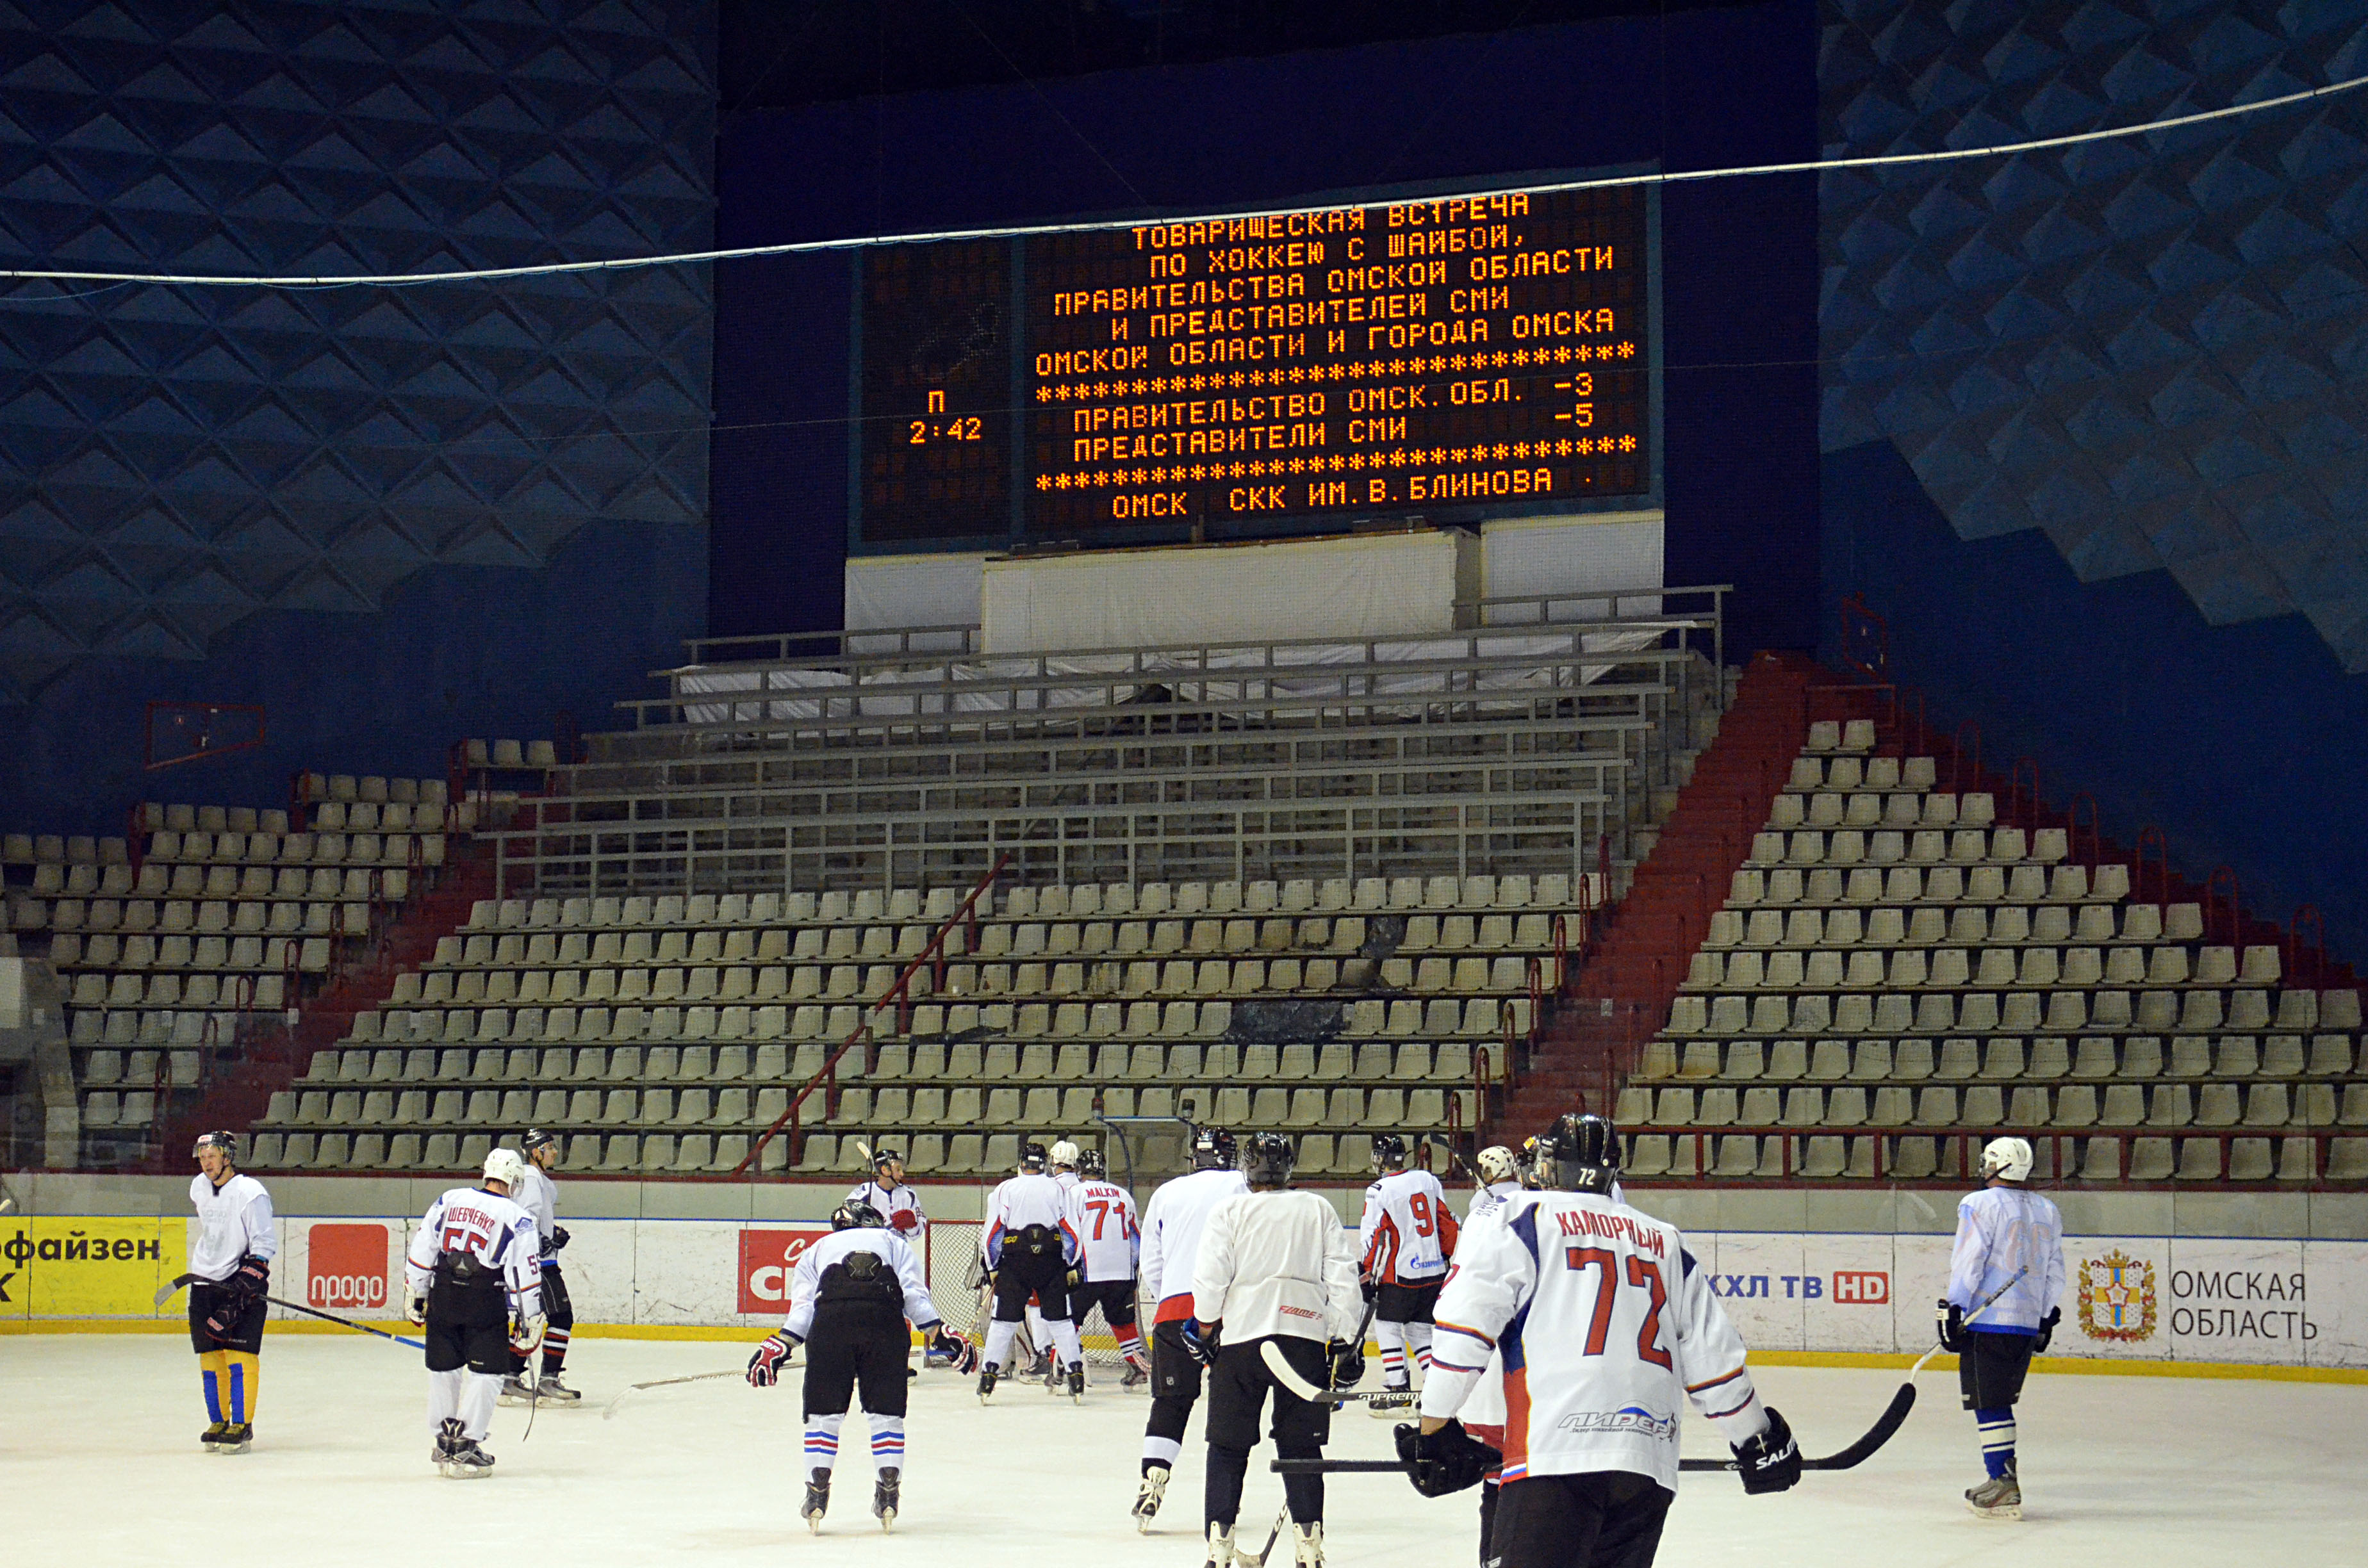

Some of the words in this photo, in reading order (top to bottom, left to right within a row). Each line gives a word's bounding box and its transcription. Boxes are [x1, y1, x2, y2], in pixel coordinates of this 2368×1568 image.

[1132, 208, 1365, 250] ТОВАРИЩЕСКАЯ
[1388, 192, 1528, 227] ВСТРЕЧА
[1151, 254, 1186, 277] ПО
[1209, 241, 1324, 273] ХОККЕЮ
[1348, 238, 1364, 260] С
[1055, 273, 1304, 315] ПРАВИТЕЛЬСТВА
[1328, 261, 1445, 293] ОМСКОЙ
[1470, 245, 1613, 281] ОБЛАСТИ
[1112, 318, 1128, 340] И
[1151, 293, 1426, 338] ПРЕДСТАВИТЕЛЕЙ
[1451, 286, 1508, 313] СМИ
[1036, 346, 1147, 376] ОМСКОЙ
[1170, 333, 1305, 365] ОБЛАСТИ
[1328, 329, 1344, 353] И
[1369, 318, 1488, 350] ГОРОДА
[1512, 307, 1614, 339] ОМСКА
[928, 390, 945, 413] П
[1074, 392, 1325, 432] ПРАВИТЕЛЬСТВО
[910, 416, 982, 444] 2:42
[1074, 423, 1325, 462] ПРЕДСТАВИТЕЛИ
[1349, 416, 1406, 443] СМИ
[1112, 491, 1187, 518] ОМСК
[1229, 485, 1285, 511] СКК
[1410, 468, 1552, 500] БЛИНОВА
[1085, 1187, 1121, 1199] MALKIN
[1577, 1168, 1597, 1186] 72
[447, 1207, 496, 1234] ШЕВЧЕНКО
[1085, 1200, 1128, 1241] 71
[1409, 1191, 1435, 1238] 9
[0, 1230, 160, 1269] файзен
[1555, 1209, 1665, 1260] КАМОРНЫЙ
[1780, 1275, 1823, 1299] ТВ
[1837, 1275, 1886, 1300] HD
[2172, 1270, 2306, 1302] ОМСКАЯ
[1565, 1246, 1673, 1375] 72
[2173, 1307, 2318, 1340] ОБЛАСТЬ
[1358, 1392, 1422, 1401] SUPREM
